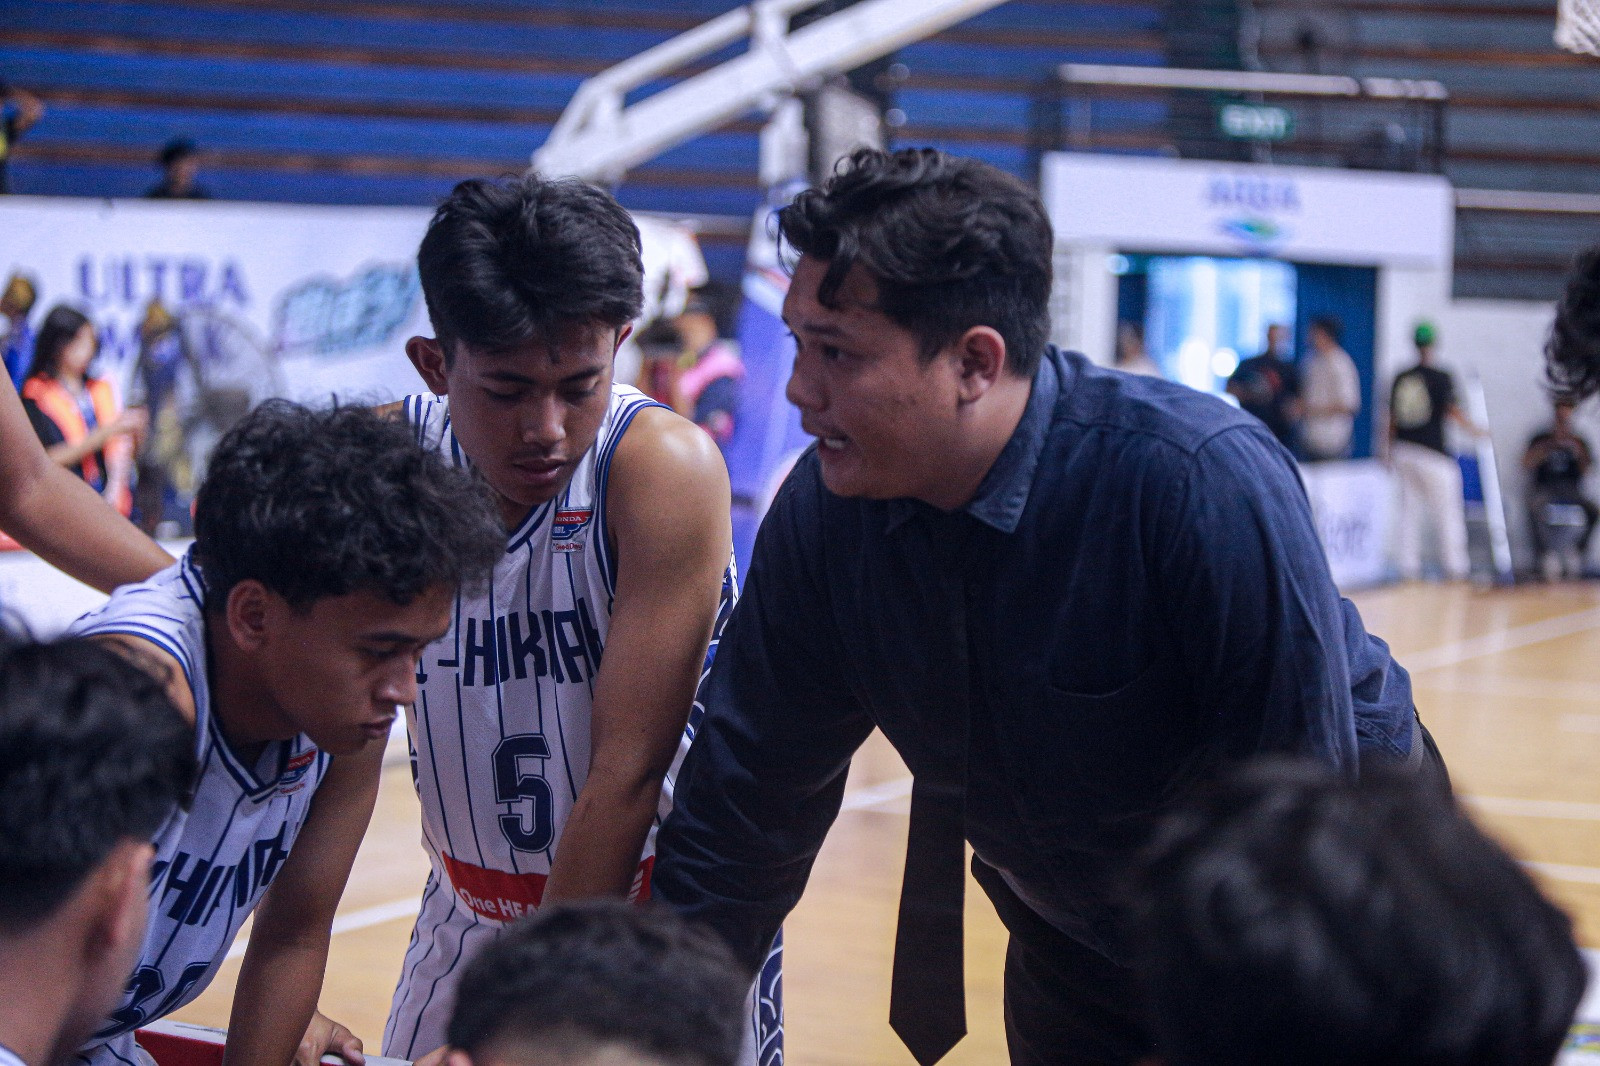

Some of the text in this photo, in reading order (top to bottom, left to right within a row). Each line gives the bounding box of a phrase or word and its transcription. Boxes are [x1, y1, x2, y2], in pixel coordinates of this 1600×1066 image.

[491, 732, 555, 854] 5
[459, 887, 541, 919] One HEA
